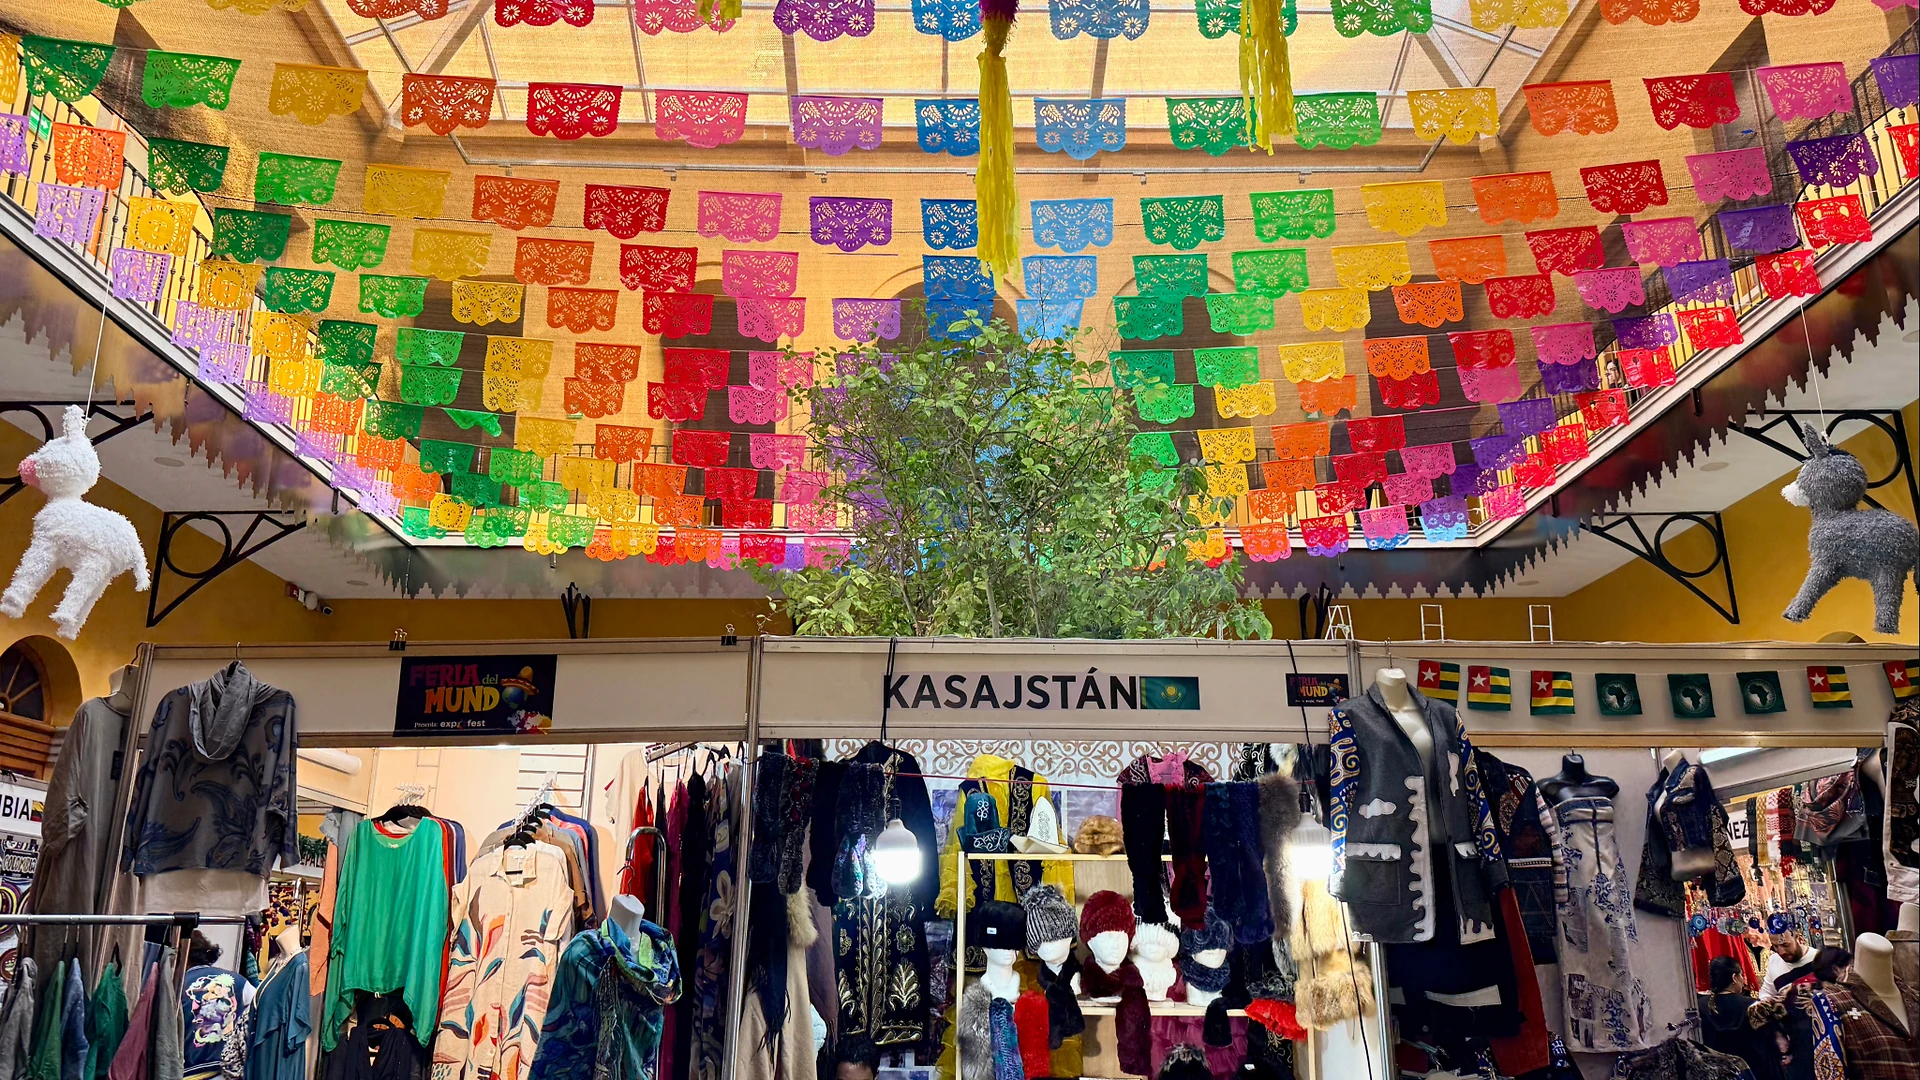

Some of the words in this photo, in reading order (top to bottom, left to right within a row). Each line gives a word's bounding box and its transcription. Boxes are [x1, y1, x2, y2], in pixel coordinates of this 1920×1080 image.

[410, 664, 480, 687] FERIA
[482, 674, 498, 685] del
[884, 667, 1137, 710] KASAJSTÁN
[467, 719, 486, 727] fest
[0, 793, 29, 820] BIA
